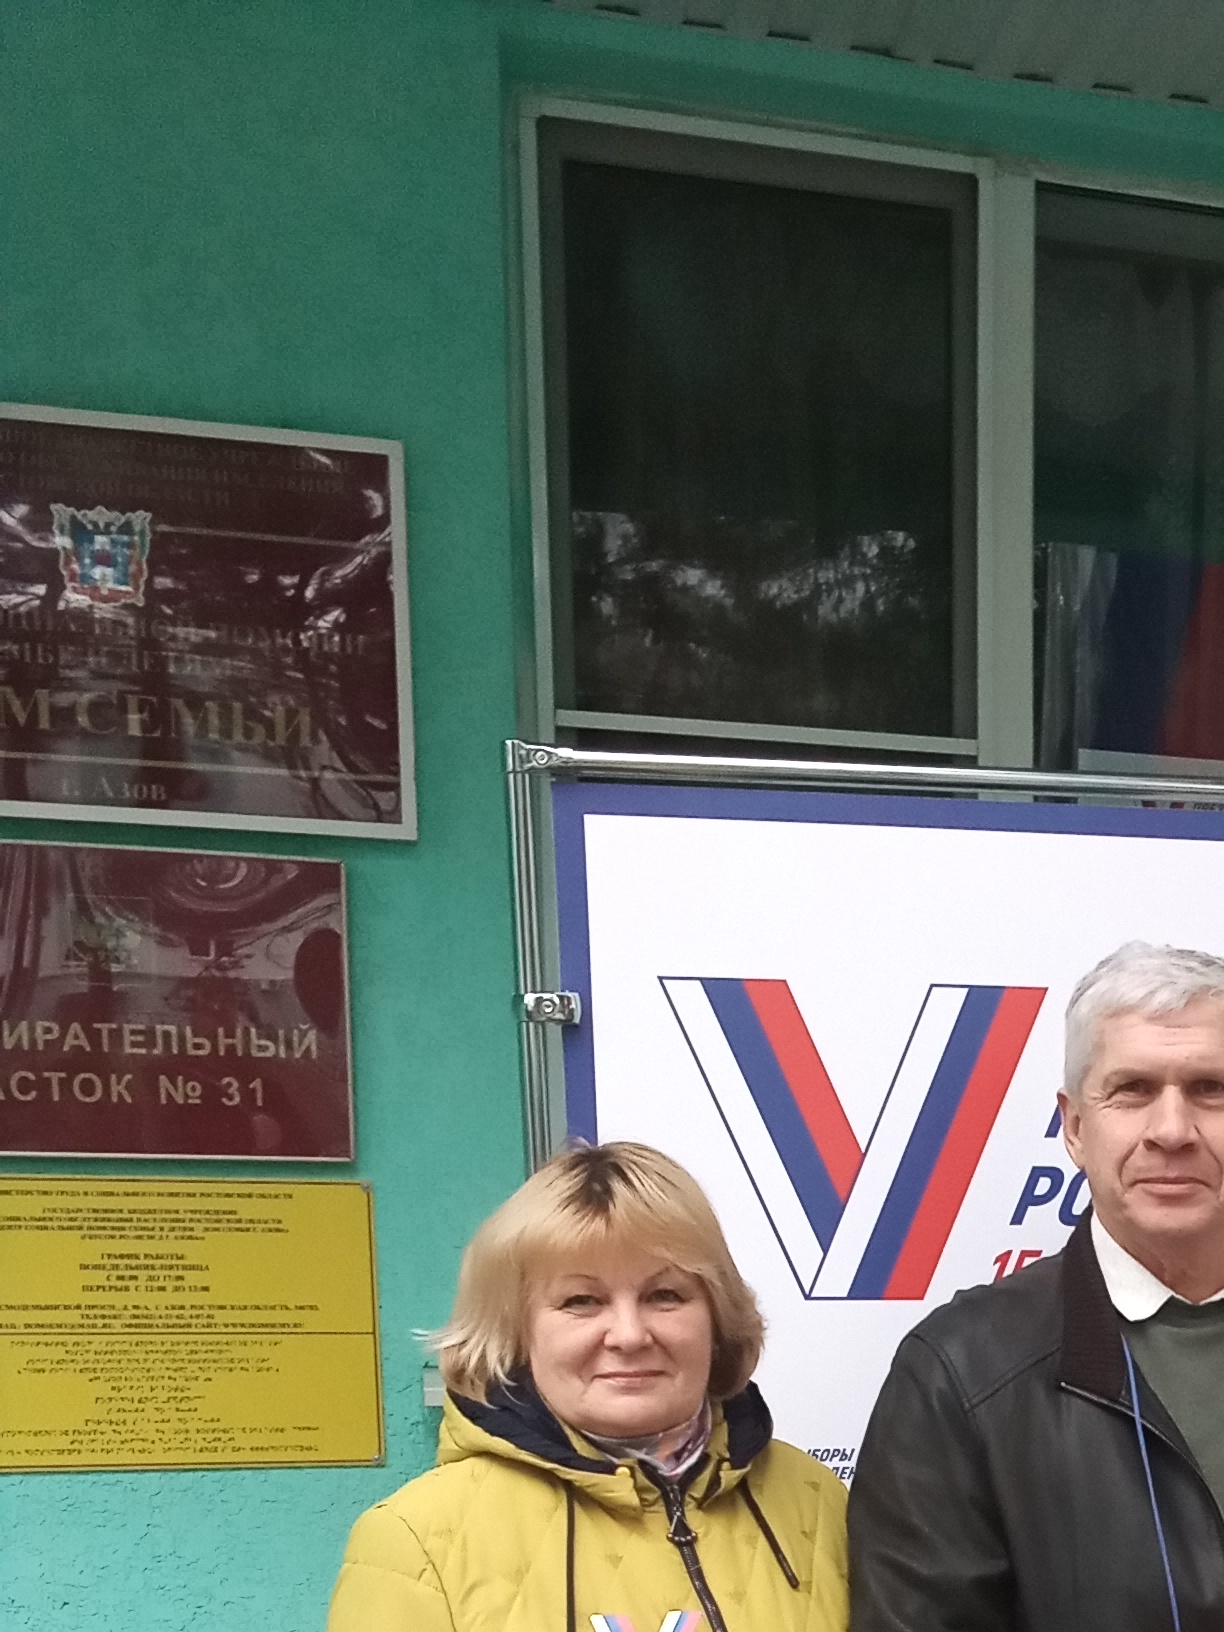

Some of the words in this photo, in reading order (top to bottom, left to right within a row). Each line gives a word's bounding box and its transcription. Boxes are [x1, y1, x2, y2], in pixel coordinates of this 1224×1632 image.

[74, 691, 313, 747] СЕМЬИ
[92, 776, 168, 800] Азов
[0, 1020, 319, 1059] ИРАТЕЛЬНЫЙ
[0, 1071, 134, 1104] СТОК
[158, 1075, 203, 1105] №
[220, 1077, 265, 1106] 31
